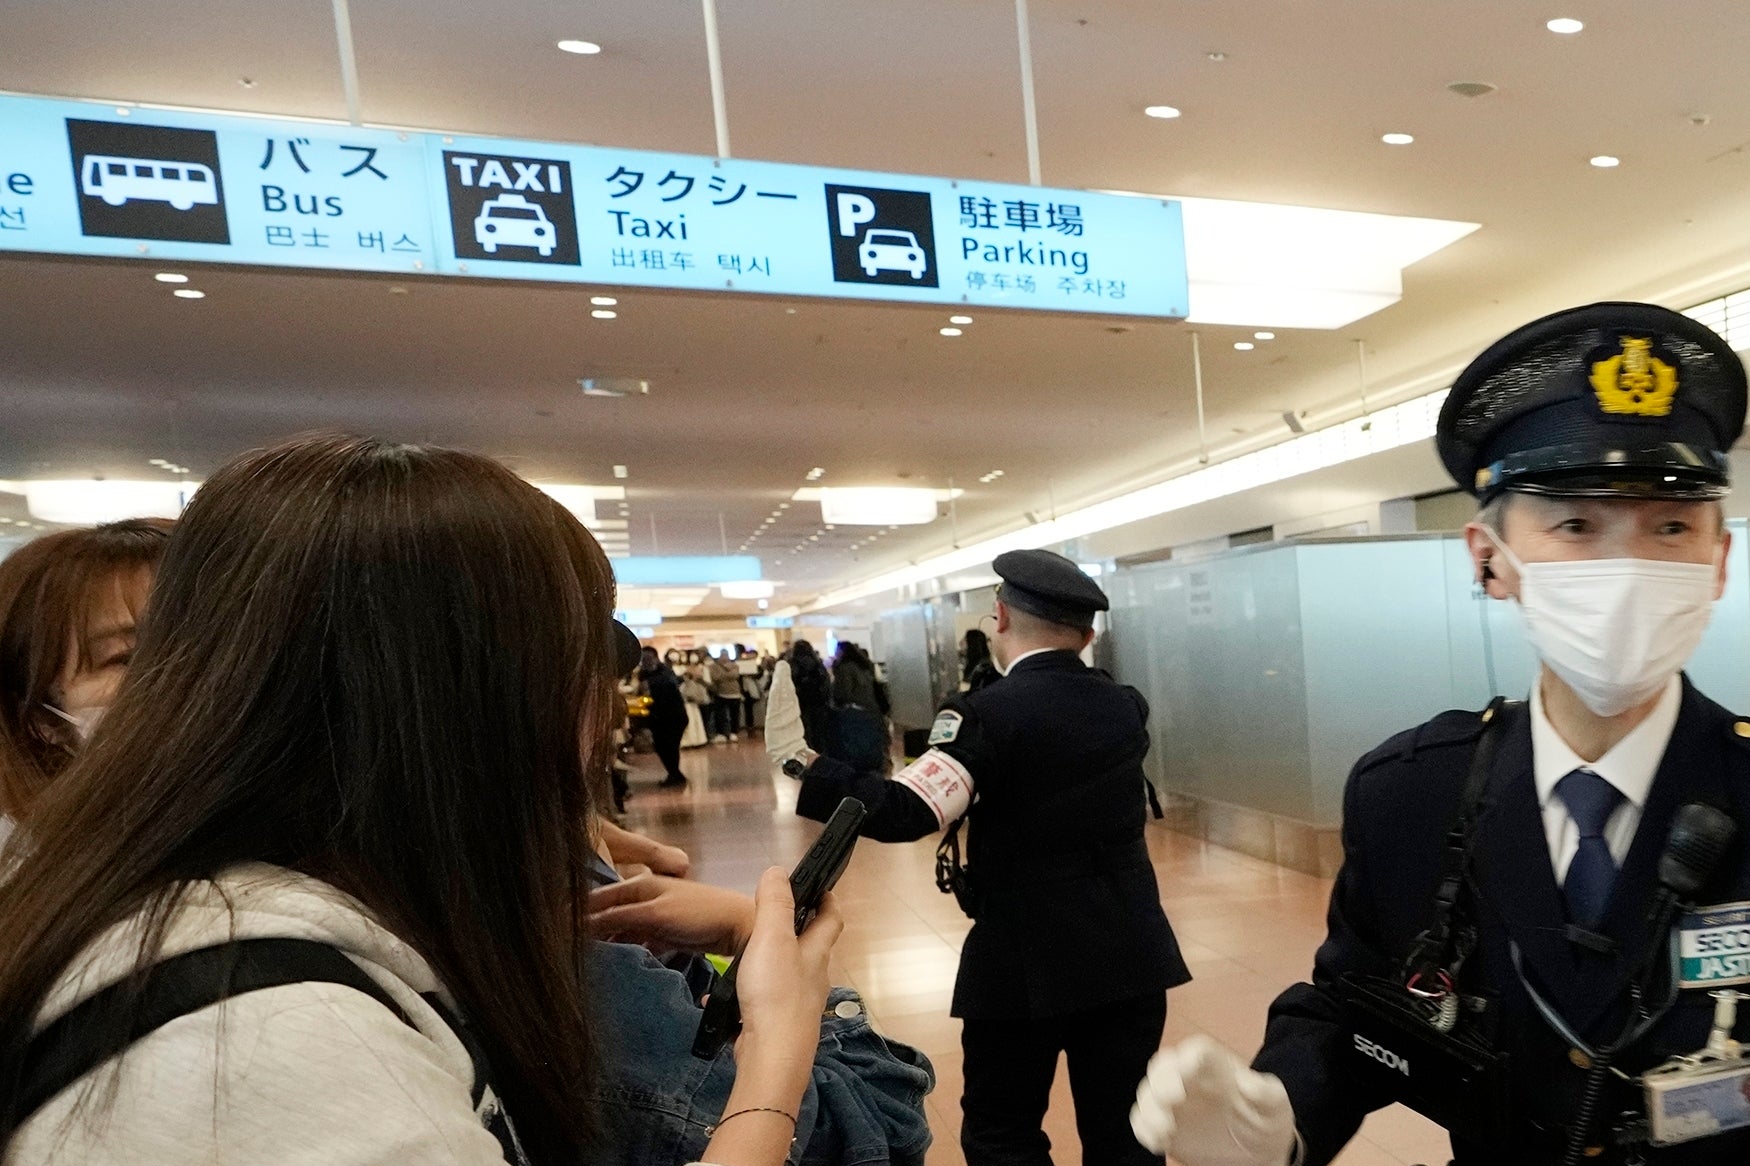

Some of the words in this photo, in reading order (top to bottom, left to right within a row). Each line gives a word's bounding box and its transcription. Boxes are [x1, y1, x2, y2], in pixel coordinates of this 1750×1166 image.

[259, 138, 388, 180] バス
[451, 157, 562, 194] TAXI
[262, 184, 343, 217] Bus
[605, 166, 798, 205] タクシー
[607, 210, 688, 240] Taxi
[836, 192, 876, 237] P
[959, 196, 1084, 237] 駐車場
[265, 225, 330, 249] 巴士
[358, 231, 422, 253] 버스
[611, 247, 696, 273] 出租车
[718, 254, 772, 276] 택시
[961, 237, 1090, 275] Parking
[966, 271, 1036, 294] 停车场
[1057, 276, 1127, 299] 주차장
[1353, 1033, 1410, 1077] SECOM
